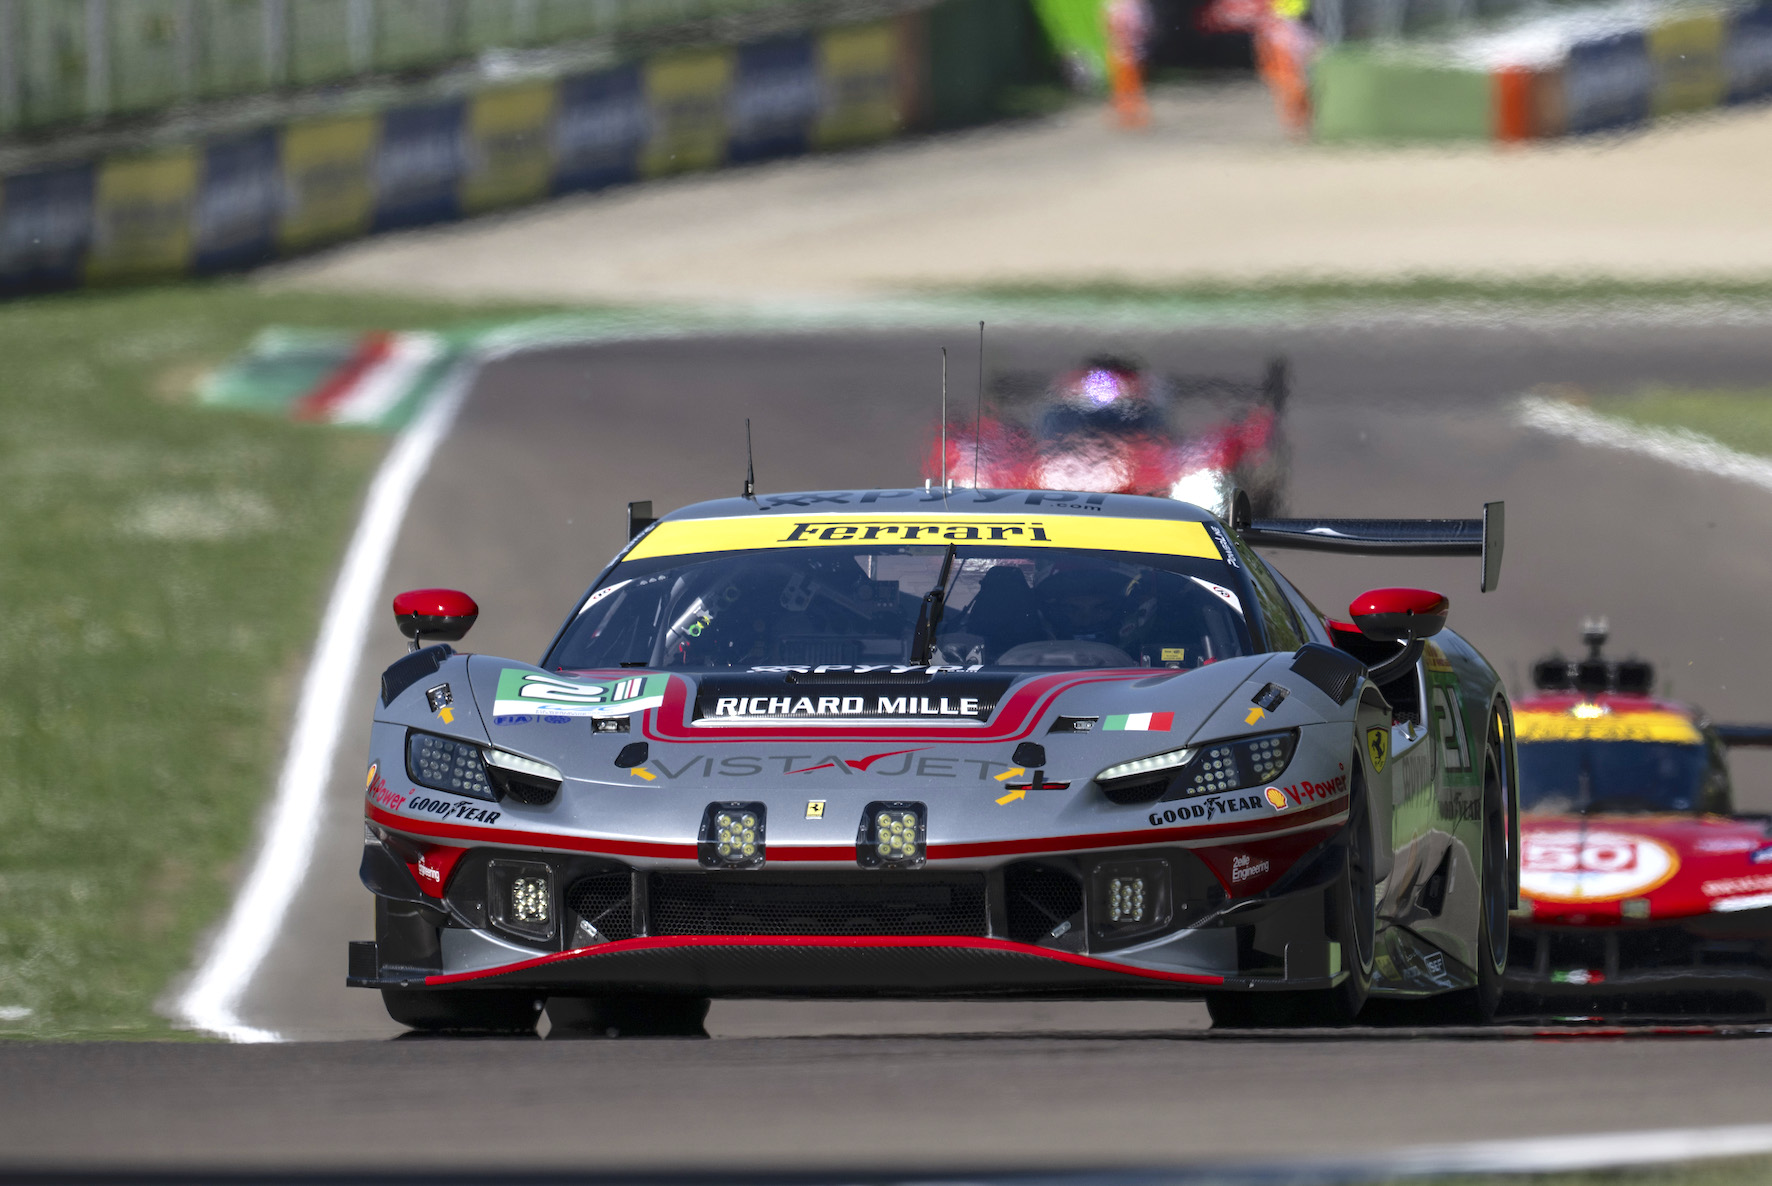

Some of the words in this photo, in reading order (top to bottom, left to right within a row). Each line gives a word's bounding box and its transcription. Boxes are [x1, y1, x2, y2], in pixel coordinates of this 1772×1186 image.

[777, 522, 1052, 543] Ferrari
[715, 697, 864, 716] RICHARD
[877, 697, 979, 716] MILLE
[1433, 684, 1472, 773] 21
[369, 773, 407, 811] V-Power
[1284, 774, 1347, 806] V-Power
[409, 796, 501, 825] GOODYEAR
[1149, 795, 1263, 827] GOODYEAR
[1232, 860, 1270, 880] Engineering
